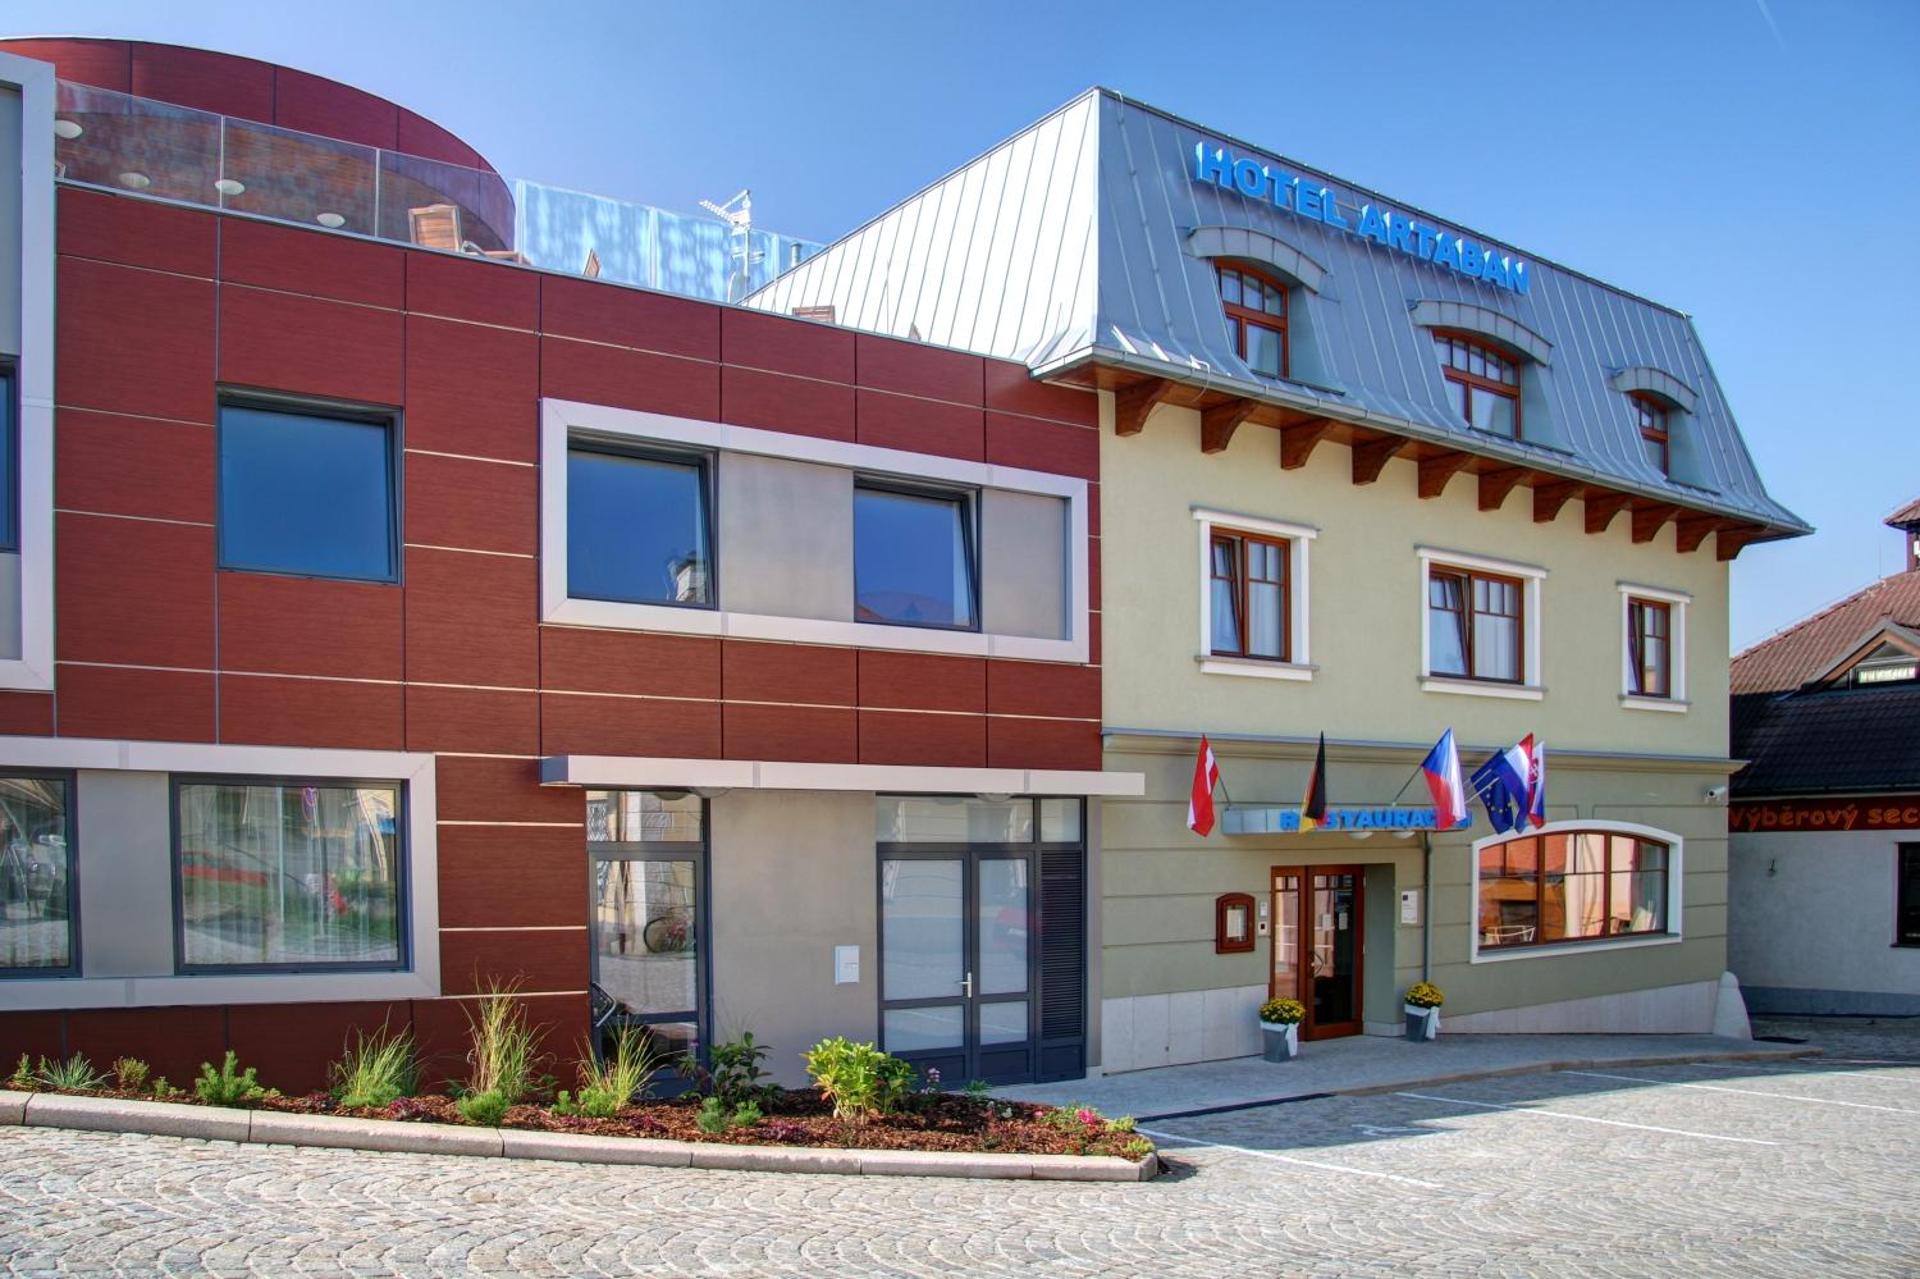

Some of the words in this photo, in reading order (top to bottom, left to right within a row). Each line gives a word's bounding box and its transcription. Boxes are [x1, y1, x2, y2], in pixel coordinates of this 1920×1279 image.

[1196, 141, 1347, 229] HOTEL
[1358, 204, 1529, 294] ARTABAN
[1867, 808, 1920, 824] sec
